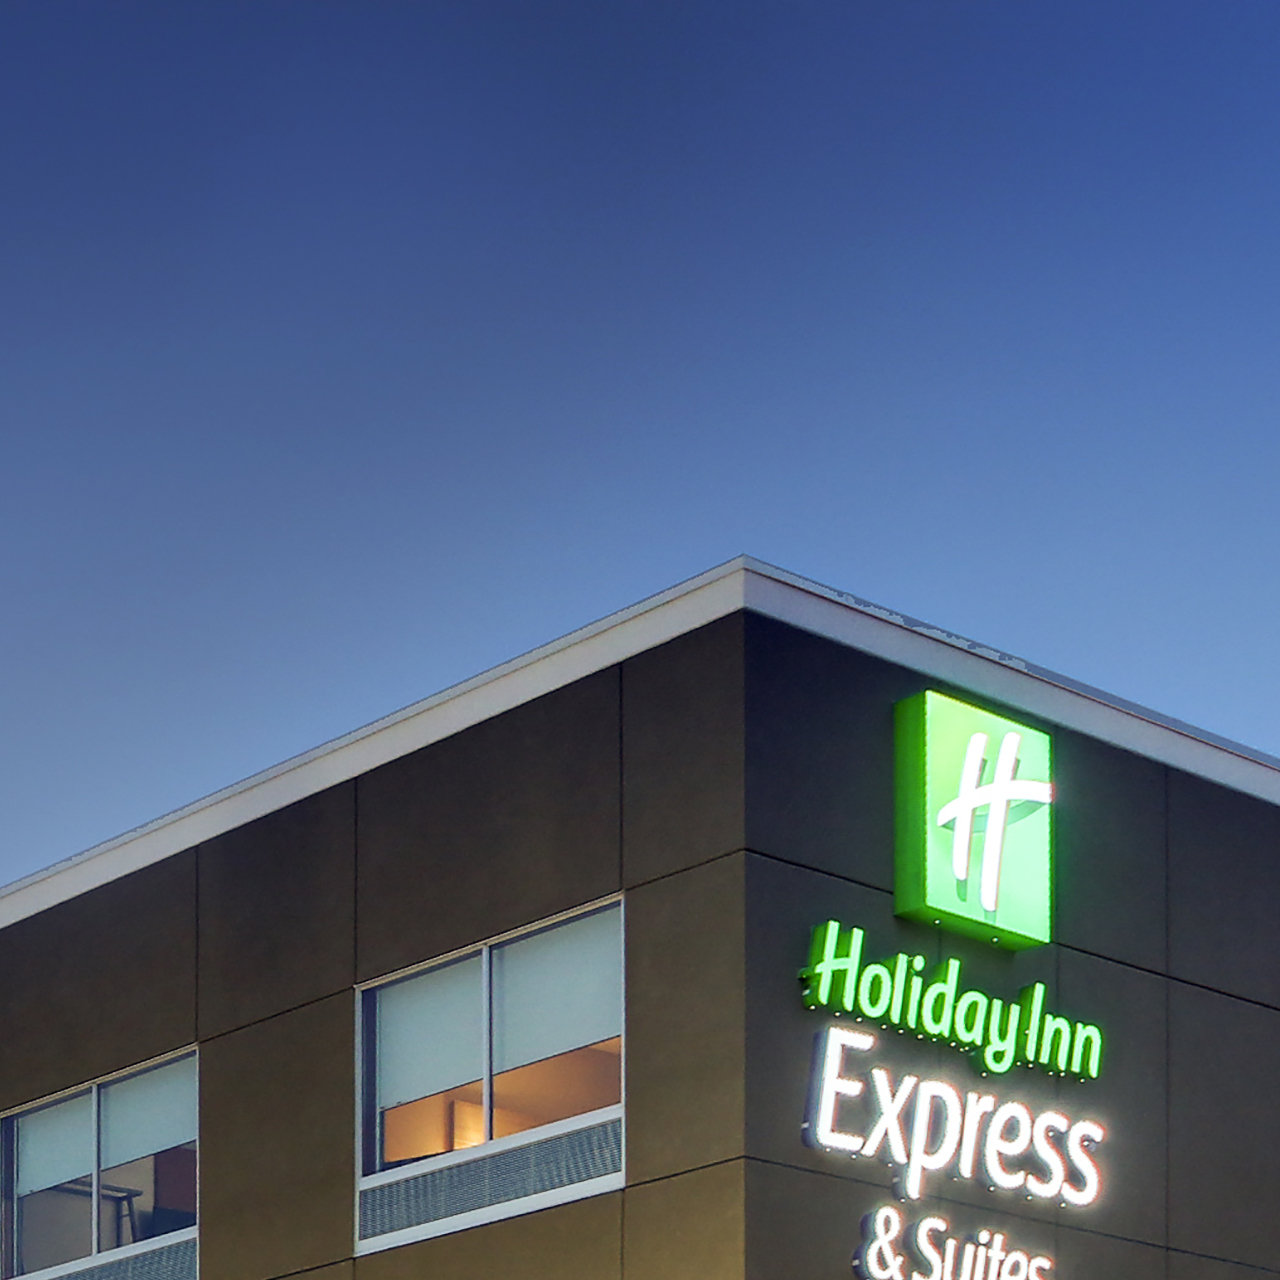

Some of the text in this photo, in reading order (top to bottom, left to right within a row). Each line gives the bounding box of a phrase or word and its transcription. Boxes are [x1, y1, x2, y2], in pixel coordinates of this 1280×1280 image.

[810, 920, 1102, 1080] Holiday Inn
[815, 1026, 1106, 1207] Express
